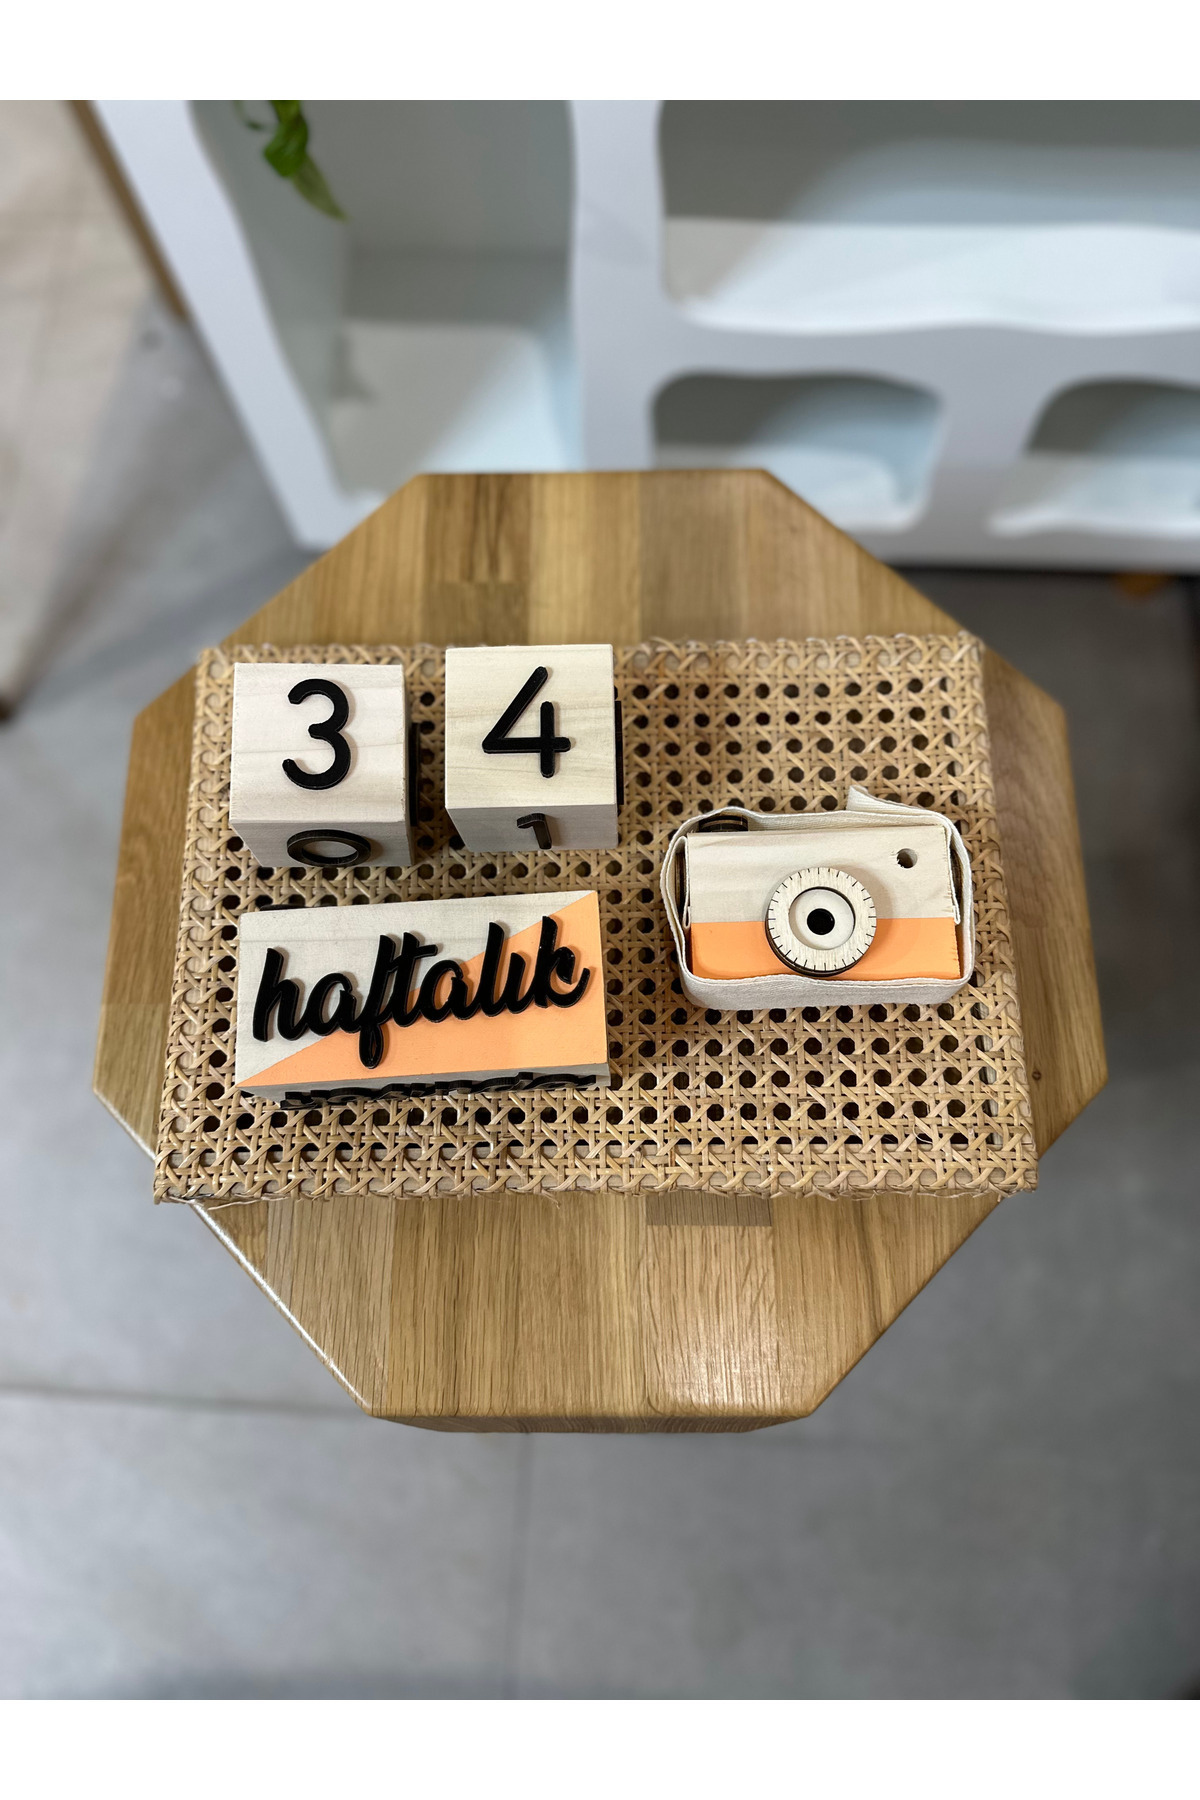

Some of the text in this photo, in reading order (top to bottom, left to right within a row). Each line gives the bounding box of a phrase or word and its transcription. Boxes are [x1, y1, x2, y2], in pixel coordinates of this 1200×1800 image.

[282, 678, 351, 790] 3
[482, 666, 571, 778] 4
[252, 915, 591, 1069] haftalık
